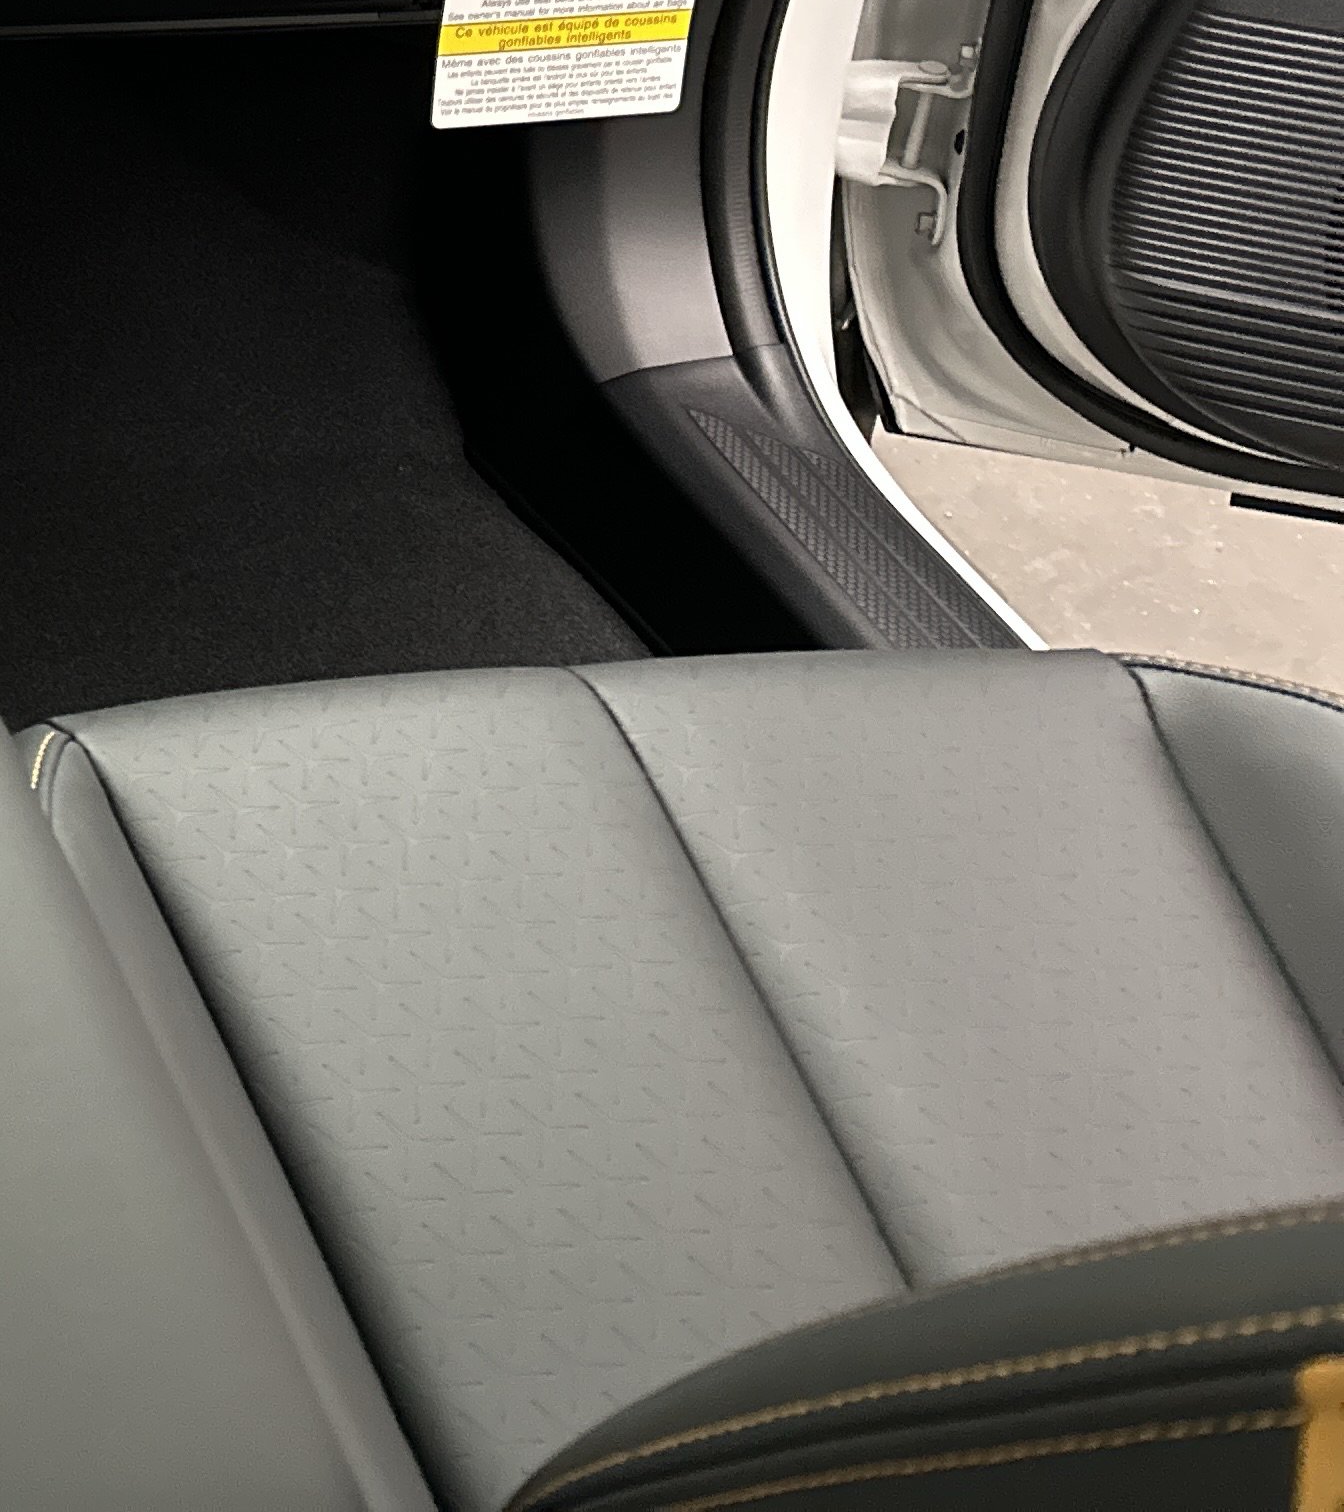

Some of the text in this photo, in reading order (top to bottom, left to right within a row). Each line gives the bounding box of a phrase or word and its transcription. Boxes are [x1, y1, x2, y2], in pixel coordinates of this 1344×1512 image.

[455, 14, 677, 39] Ce véhicule est équipé de coussins
[498, 30, 631, 51] gonflables intelligents
[442, 59, 473, 69] Même
[477, 57, 501, 67] avec
[505, 55, 524, 64] des
[528, 53, 571, 63] coussins
[576, 49, 626, 62] gonflables
